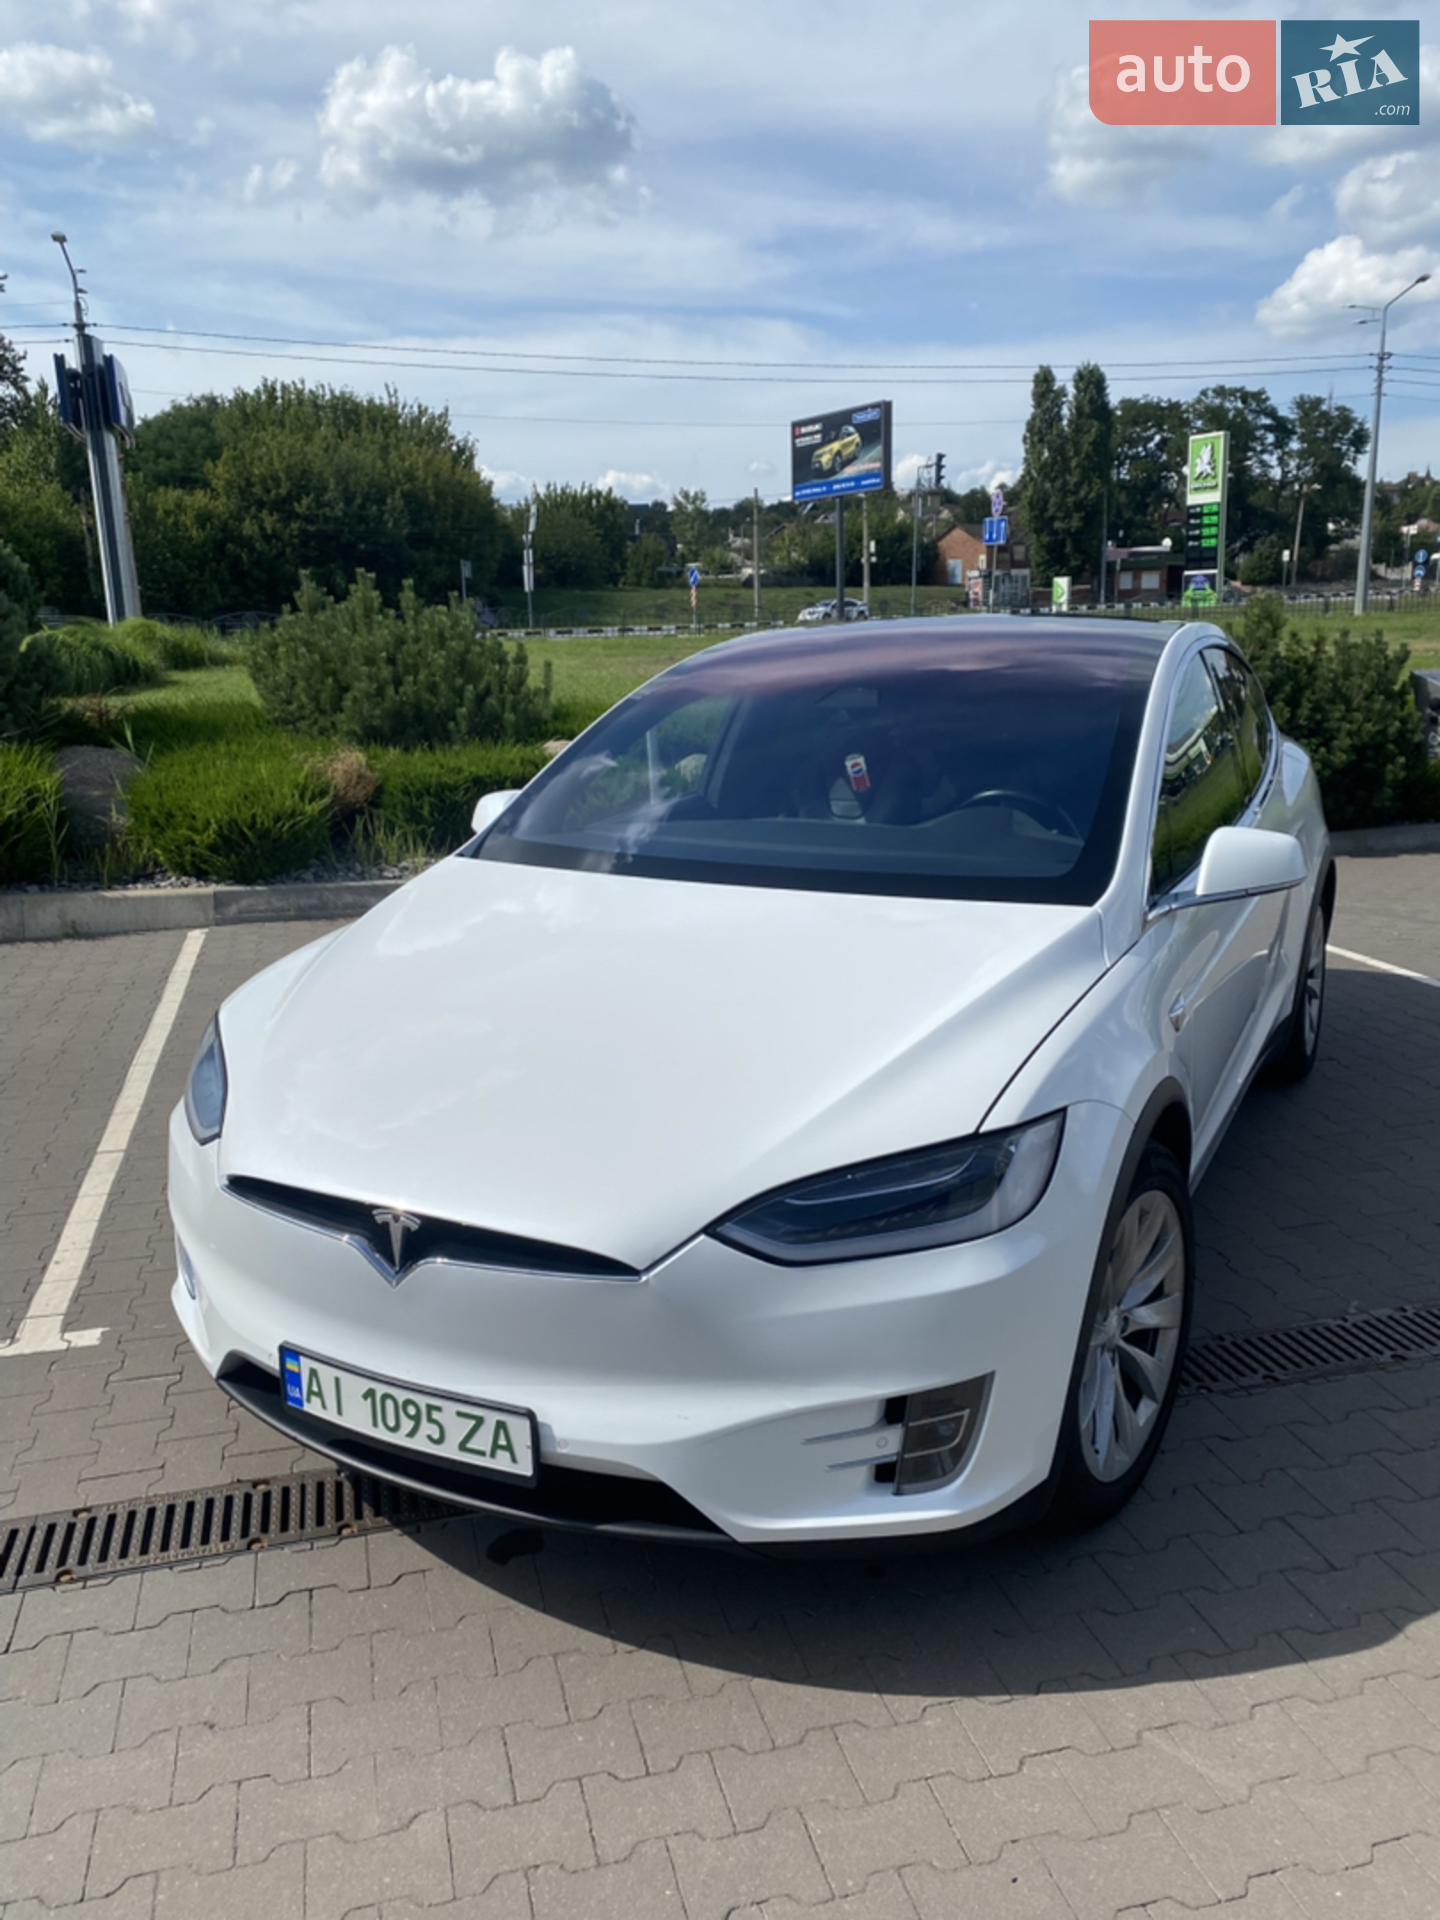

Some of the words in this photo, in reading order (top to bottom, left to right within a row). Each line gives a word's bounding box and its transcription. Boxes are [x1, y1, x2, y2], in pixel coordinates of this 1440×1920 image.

[287, 1384, 301, 1399] UA
[306, 1366, 343, 1417] AI
[361, 1387, 446, 1446] 1095
[455, 1410, 518, 1464] ZA
